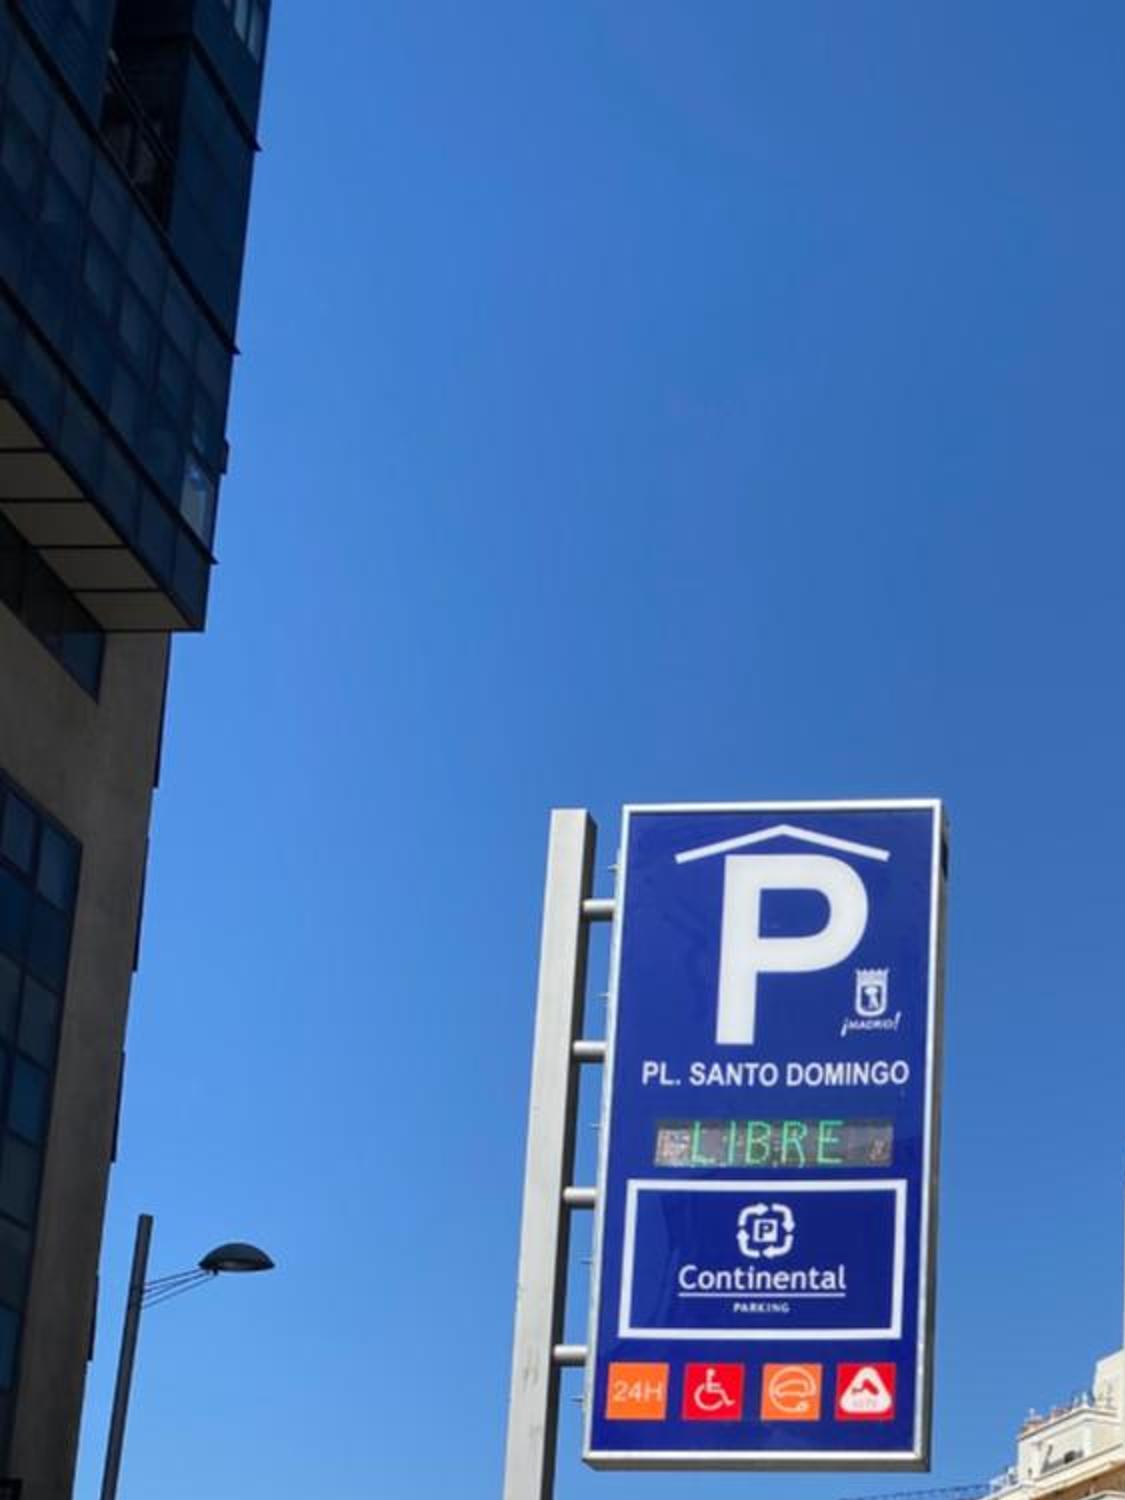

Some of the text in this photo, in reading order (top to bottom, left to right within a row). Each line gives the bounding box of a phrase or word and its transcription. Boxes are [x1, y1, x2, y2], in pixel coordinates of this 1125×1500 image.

[716, 854, 868, 1044] P
[642, 1060, 909, 1087] PL. SANTO DOMINGO
[691, 1120, 843, 1168] LIBRE
[678, 1264, 846, 1290] Continental
[733, 1302, 790, 1313] PARKING
[613, 1379, 662, 1402] 24H
